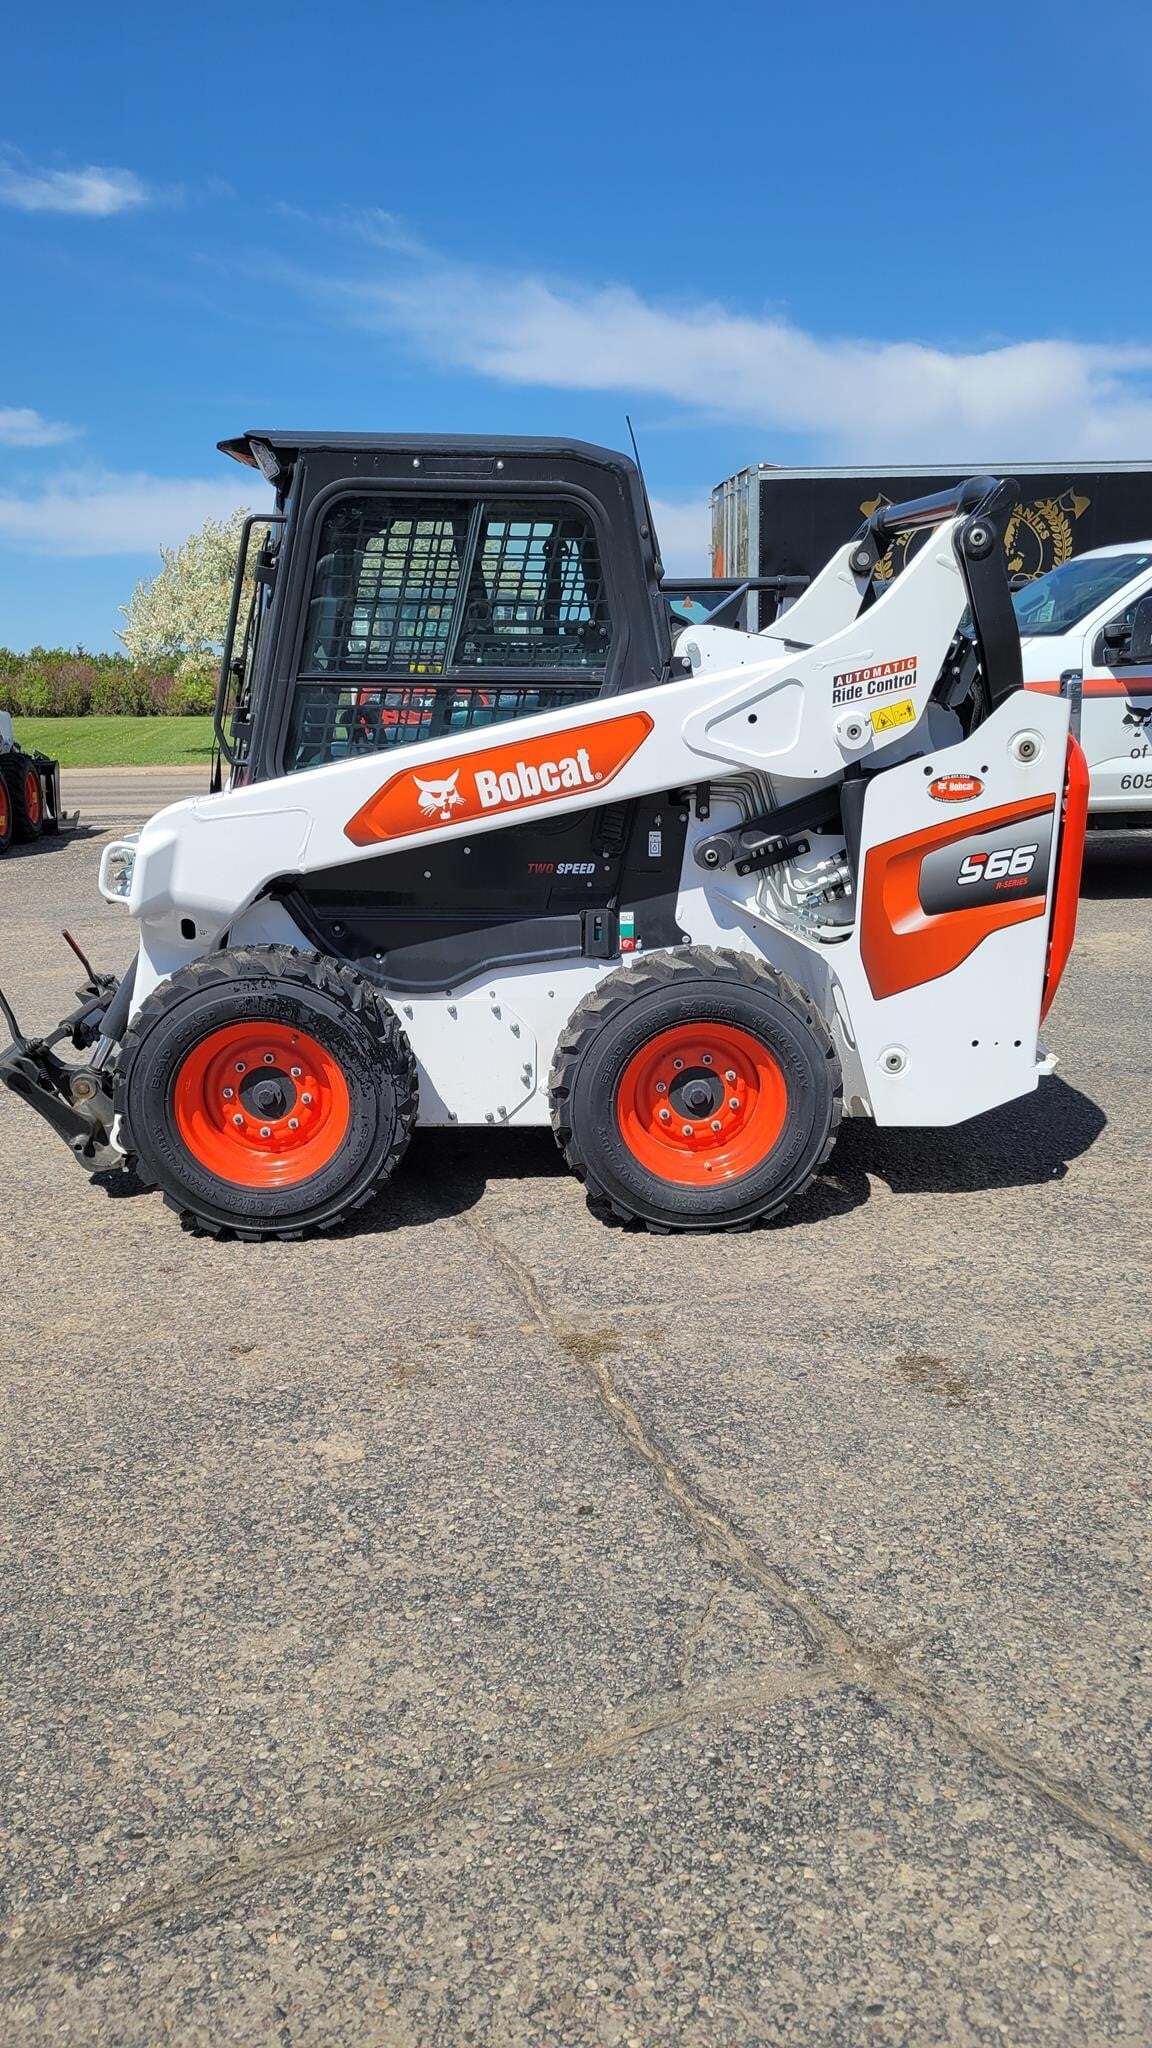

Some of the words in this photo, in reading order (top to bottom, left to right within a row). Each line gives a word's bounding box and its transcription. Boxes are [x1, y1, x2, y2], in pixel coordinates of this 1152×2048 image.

[836, 659, 915, 687] AUTOMATIC
[832, 686, 862, 704] Ride
[867, 670, 917, 695] Control
[1130, 745, 1148, 759] of
[474, 748, 595, 808] Bobcat
[949, 781, 974, 791] Bobcat
[528, 863, 554, 874] TWO
[556, 863, 596, 874] SPEED
[957, 844, 1039, 885] S66
[995, 876, 1029, 890] R-SERIES
